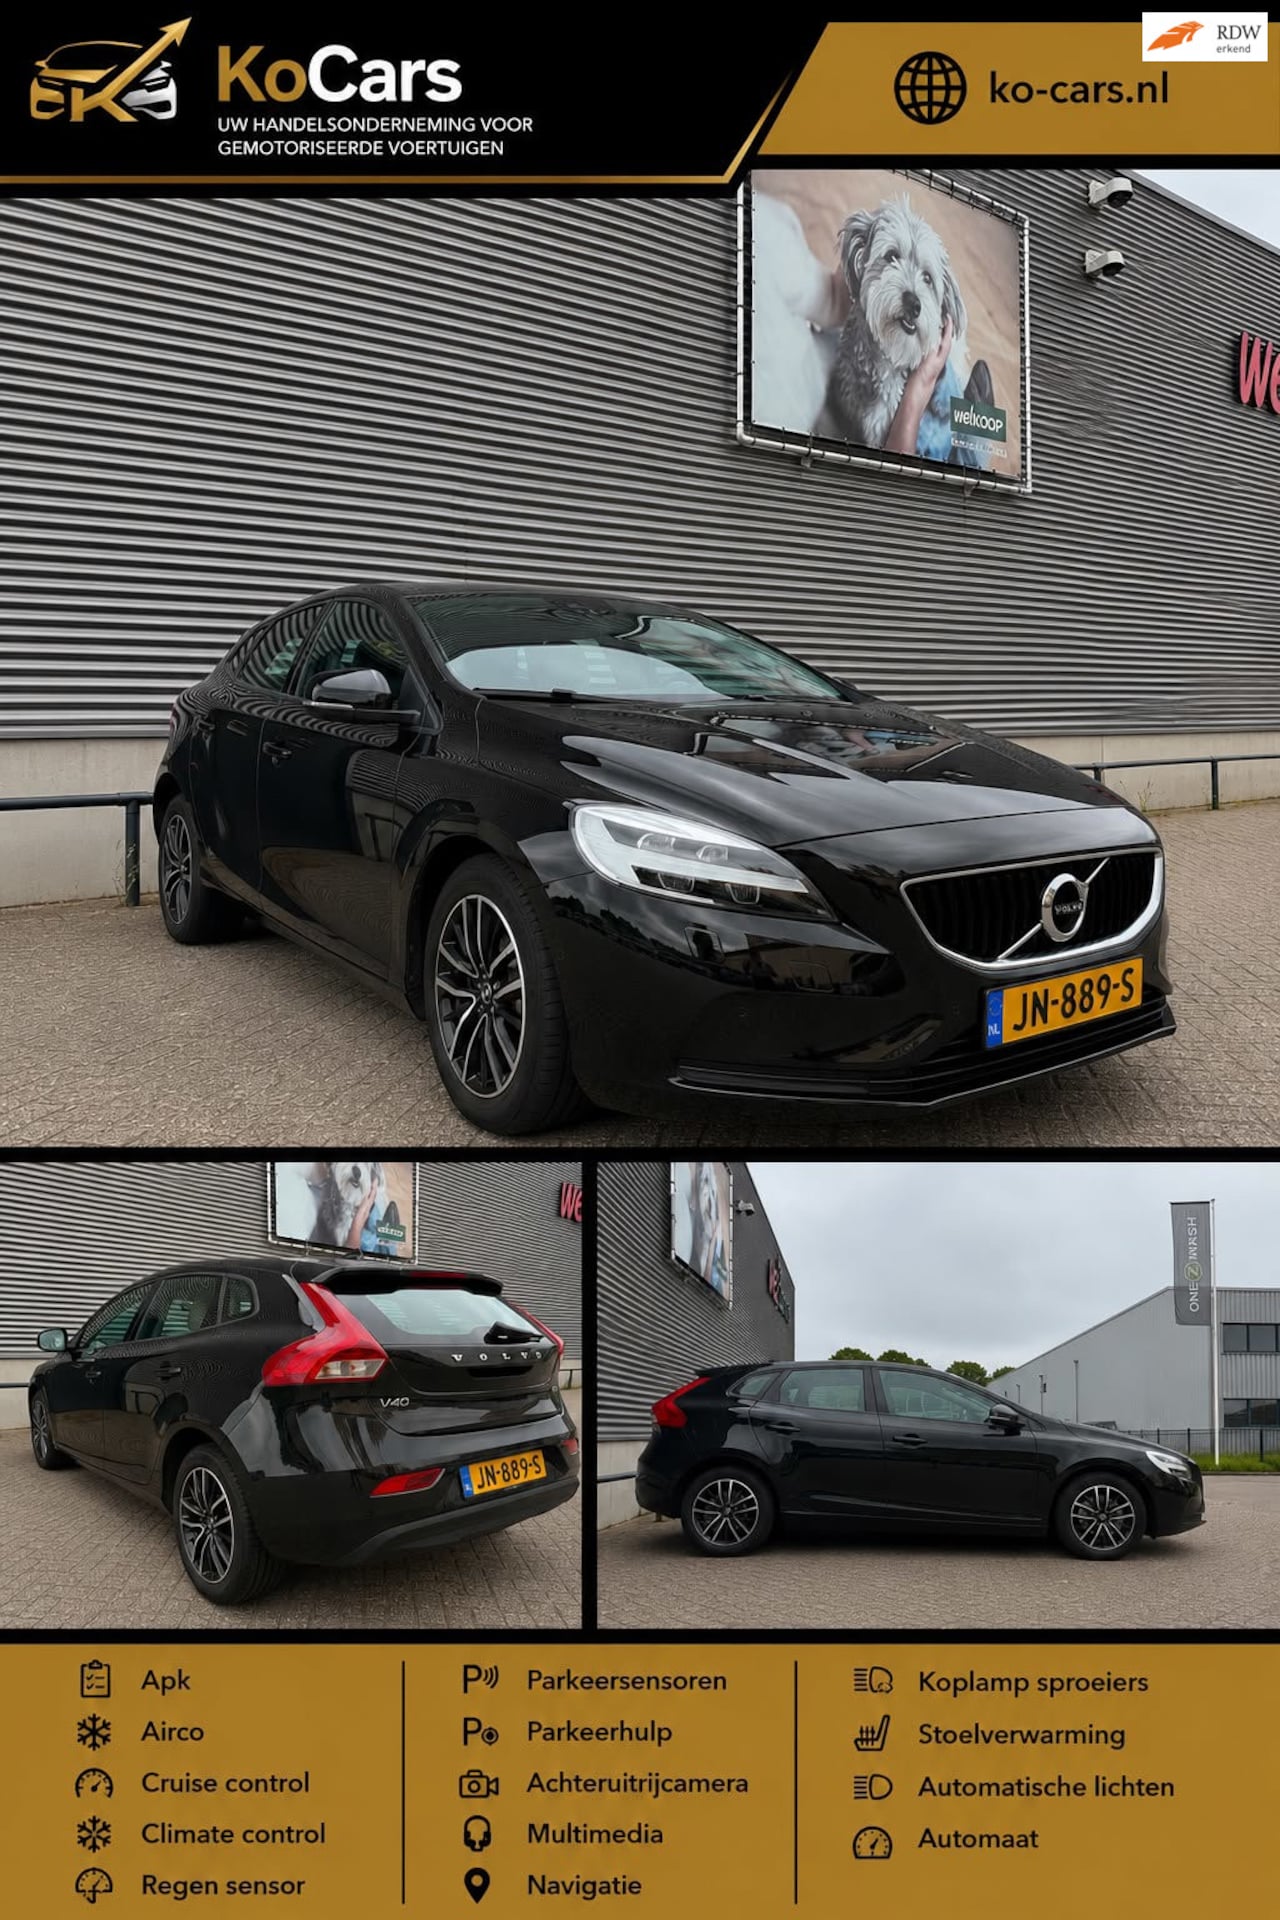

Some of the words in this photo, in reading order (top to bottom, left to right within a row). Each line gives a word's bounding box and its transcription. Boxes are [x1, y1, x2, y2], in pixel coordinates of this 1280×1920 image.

[1012, 966, 1134, 1032] JN-889-S
[987, 1022, 1001, 1036] NL
[379, 1396, 410, 1409] V40
[477, 1454, 542, 1490] JN-889-S
